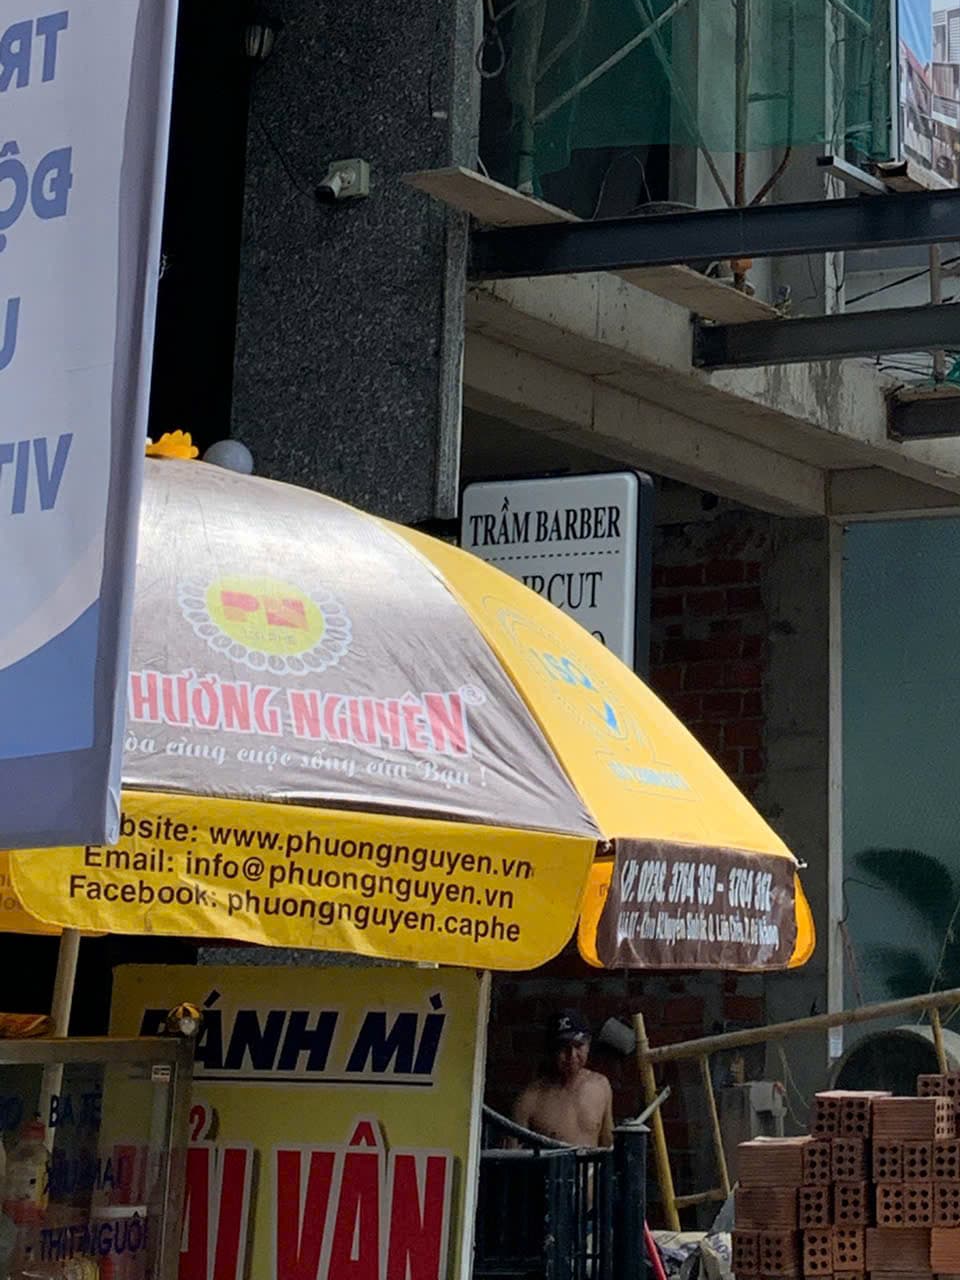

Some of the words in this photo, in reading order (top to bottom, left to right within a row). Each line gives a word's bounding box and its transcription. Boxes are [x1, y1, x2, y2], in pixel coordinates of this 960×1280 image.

[470, 496, 532, 547] TRẦM
[535, 506, 621, 543] BARBER
[128, 668, 282, 738] HƯƠNG
[123, 731, 156, 754] òa
[83, 845, 174, 874] Email:
[185, 852, 515, 910] info@phuongnguyen.vn
[119, 811, 198, 845] bsite:
[209, 823, 533, 881] www.phuongnguyen.vn
[69, 874, 218, 910] Facebook:
[227, 888, 521, 943] phuongnguyen.caphe
[345, 992, 446, 1076] MÌ
[268, 1120, 449, 1280] VÂN
